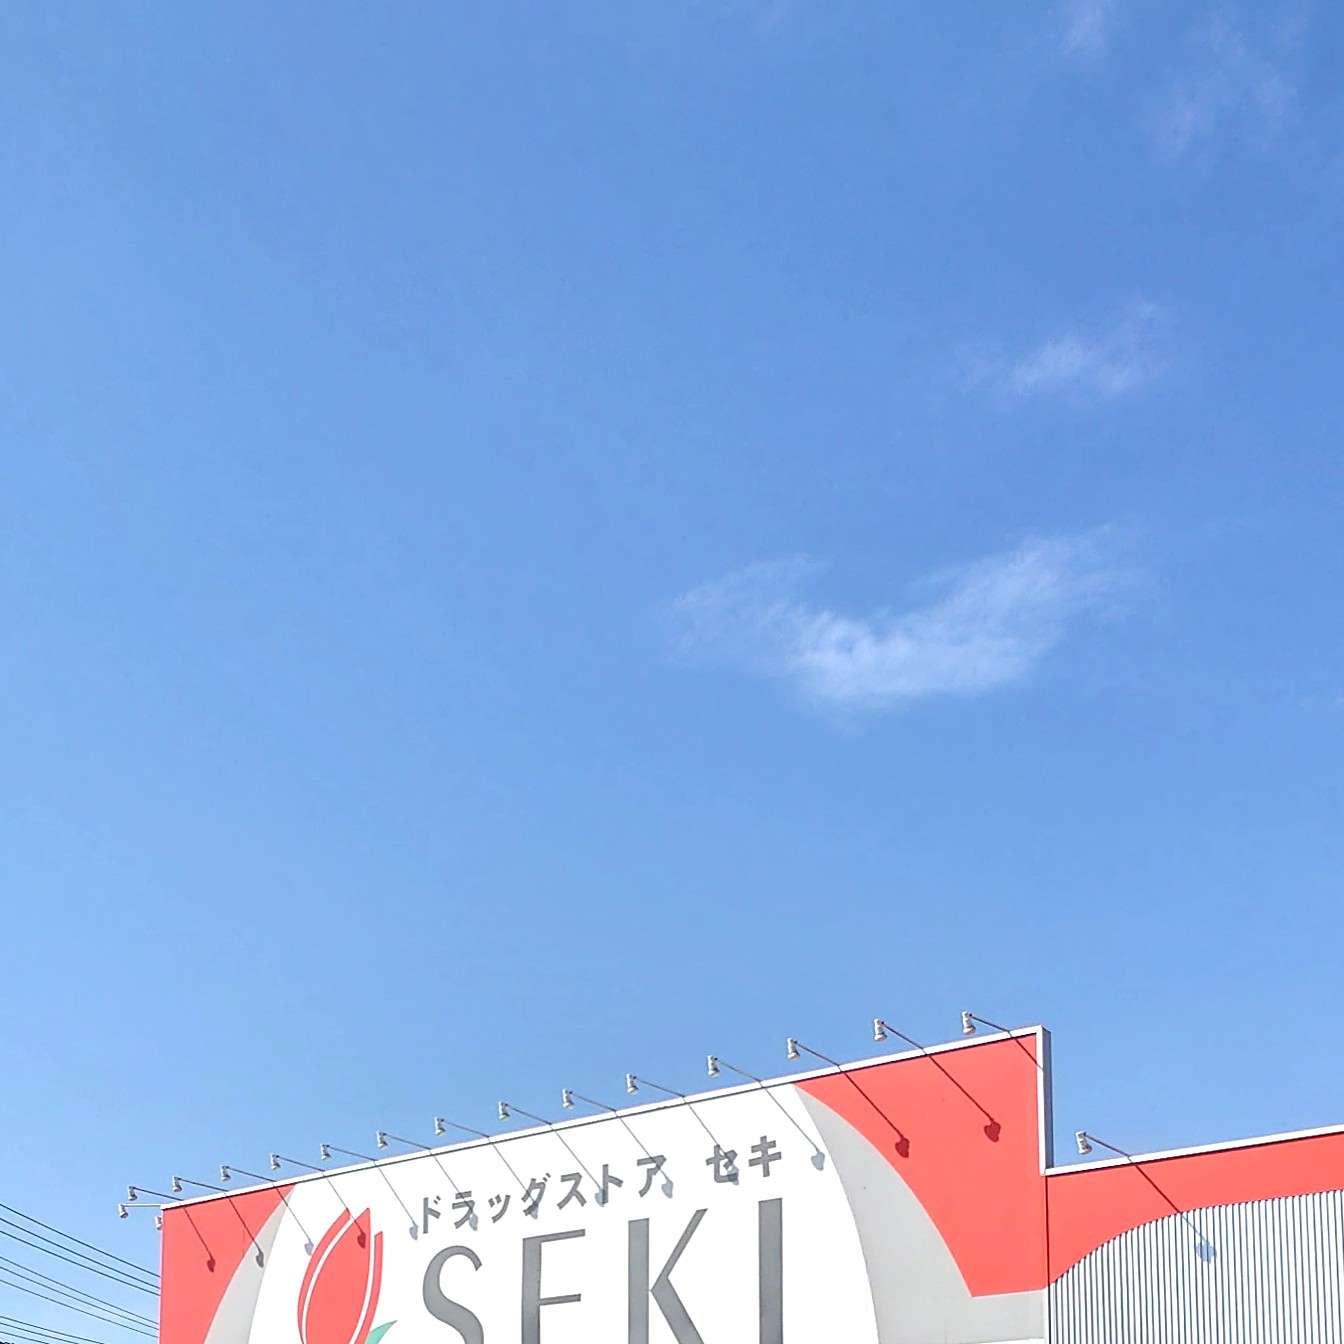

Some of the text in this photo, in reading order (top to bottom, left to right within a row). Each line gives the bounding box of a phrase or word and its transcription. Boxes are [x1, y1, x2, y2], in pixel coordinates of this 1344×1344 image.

[423, 1135, 781, 1234] ドラッグストア セキ
